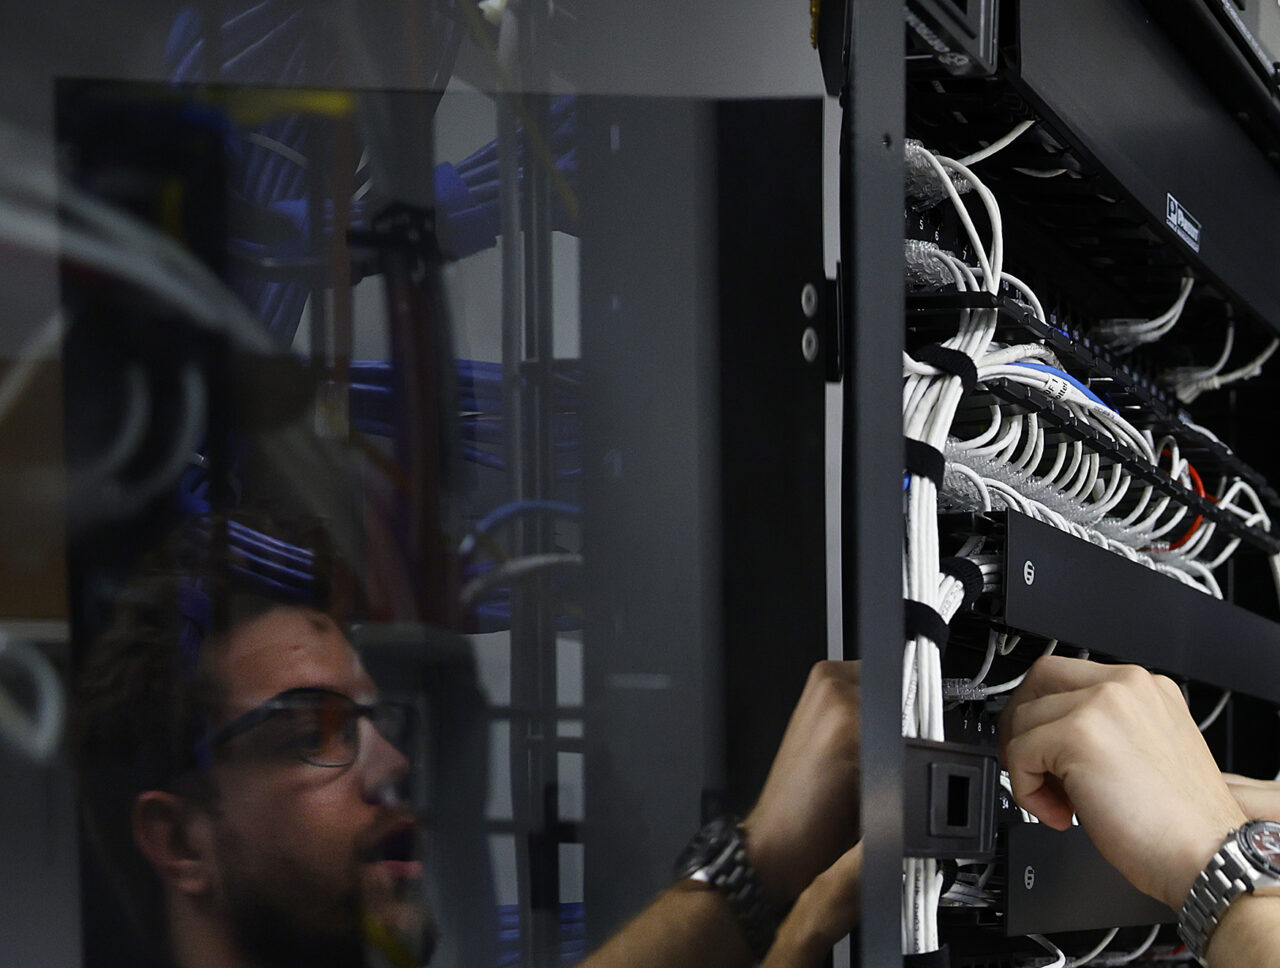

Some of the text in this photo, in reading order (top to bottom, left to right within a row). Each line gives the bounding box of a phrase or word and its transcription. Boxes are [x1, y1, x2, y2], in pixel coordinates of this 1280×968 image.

[919, 219, 924, 230] 5
[934, 230, 939, 241] 6
[962, 249, 968, 260] 7
[964, 719, 968, 729] 7
[977, 722, 982, 732] 8
